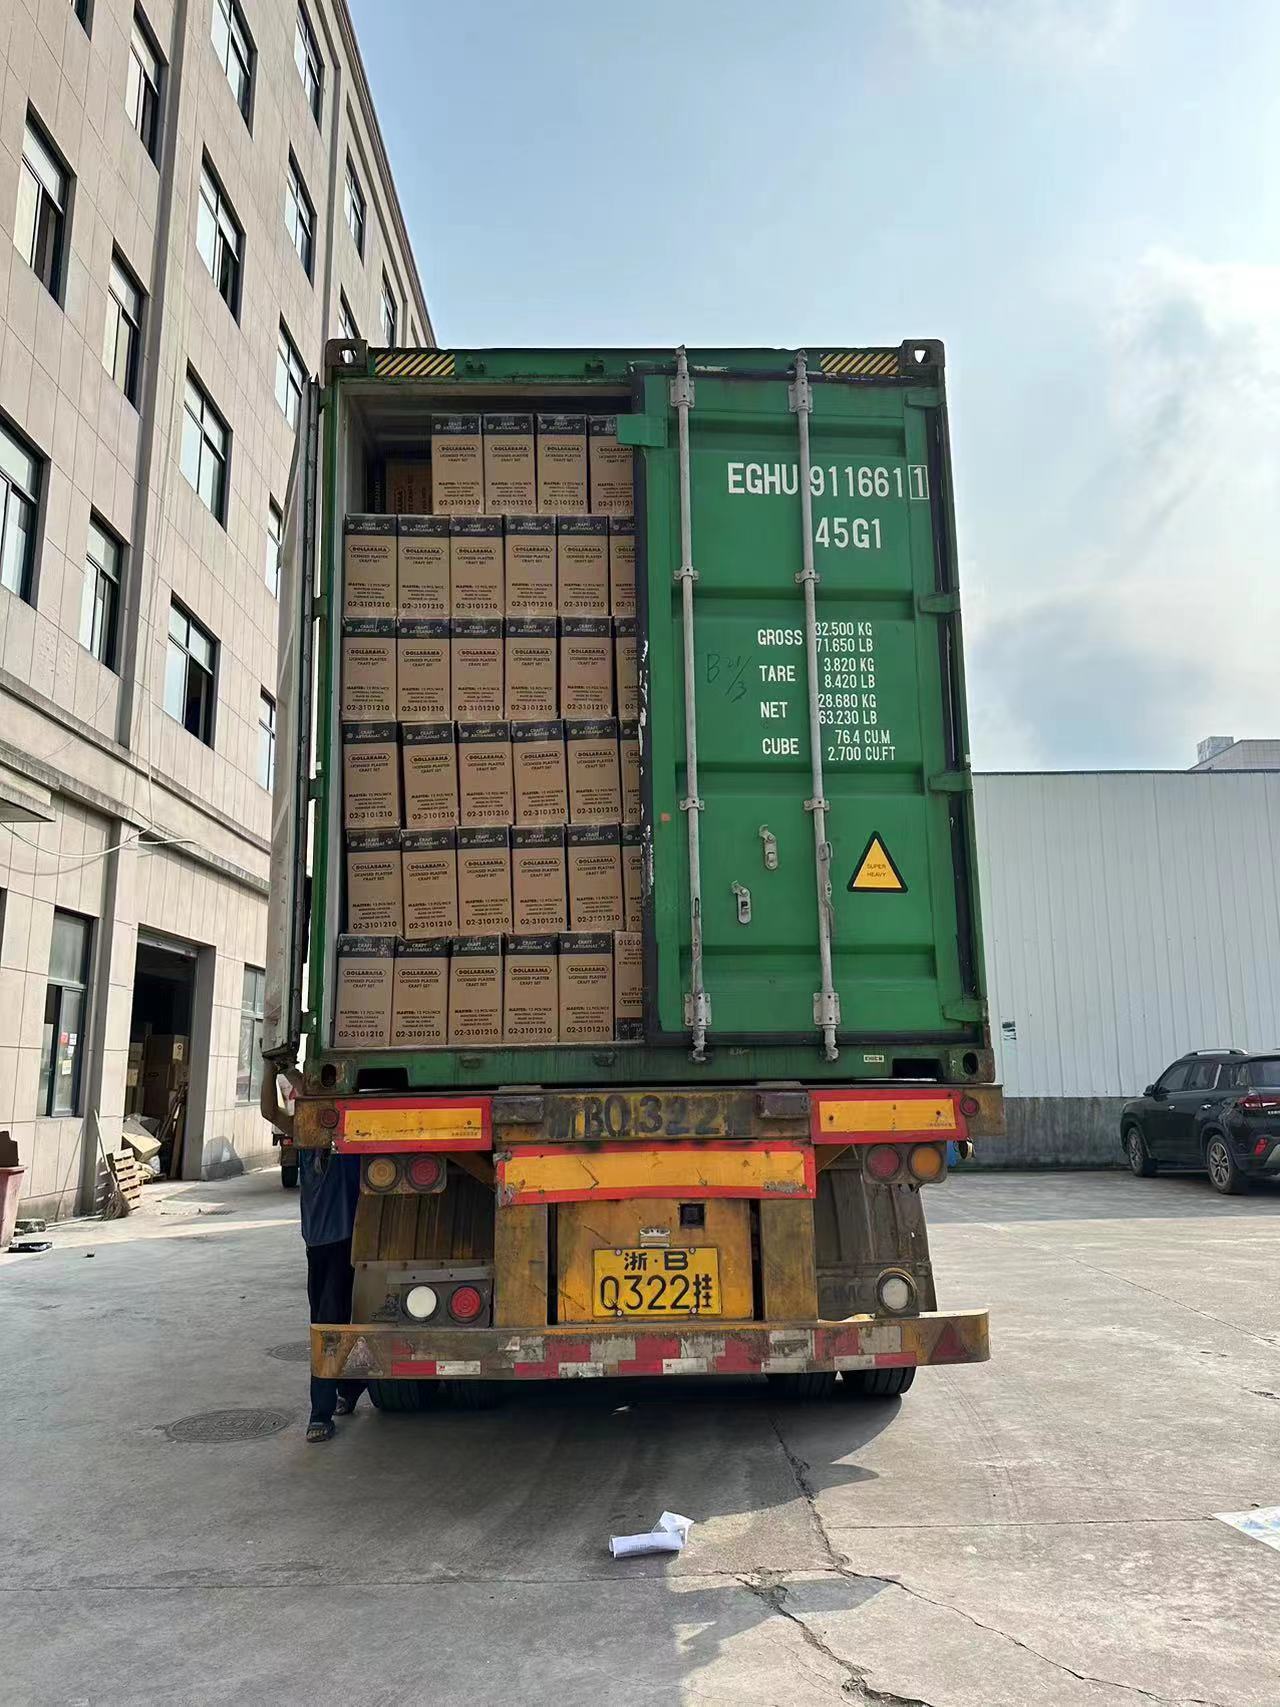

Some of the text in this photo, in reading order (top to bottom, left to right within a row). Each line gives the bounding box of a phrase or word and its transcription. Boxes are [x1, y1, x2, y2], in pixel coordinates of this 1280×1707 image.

[728, 462, 798, 495] EGHU
[810, 465, 903, 497] 911661
[438, 499, 480, 507] 02-3101210
[491, 499, 533, 507] 02-3101210
[544, 499, 584, 507] 02-3101210
[815, 517, 881, 548] 45G1
[815, 622, 872, 636] 32.500 KG
[758, 629, 803, 645] GROSS
[816, 638, 873, 652] 71.650 LB
[824, 658, 874, 671] 3.820 KG
[759, 666, 796, 682] TARE
[825, 674, 875, 688] 8.420 LB
[818, 694, 876, 708] 28.680 KG
[457, 704, 500, 712] 02-3101210
[567, 703, 608, 711] 02-3101210
[760, 702, 788, 718] NET
[819, 711, 877, 724] 63.230 LB
[835, 730, 890, 744] 76.4 CU.M
[762, 738, 799, 755] CUBE
[524, 752, 558, 760] DOLLARAMA
[828, 747, 895, 761] 2.700 CU.FT
[467, 809, 509, 817] 02-3101210
[523, 808, 566, 817] 02-3101210
[576, 806, 619, 814] 02-3101210
[349, 811, 393, 819] 02-3101210
[412, 811, 455, 820] 02-3101210
[465, 917, 510, 925] 02-3101210
[520, 917, 563, 925] 02-3101210
[577, 914, 620, 923] 02-3101210
[352, 920, 397, 929] 02-3101210
[408, 920, 452, 929] 02-3101210
[512, 966, 549, 974] DOLLARAMA
[570, 966, 606, 974] DOLLARAMA
[338, 1030, 384, 1038] 02-3101210
[395, 1030, 441, 1038] 02-3101210
[454, 1028, 499, 1036] 02-3101210
[508, 1027, 552, 1035] 02-3101210
[566, 1025, 610, 1034] 02-3101210
[601, 1274, 712, 1310] Q322挂
